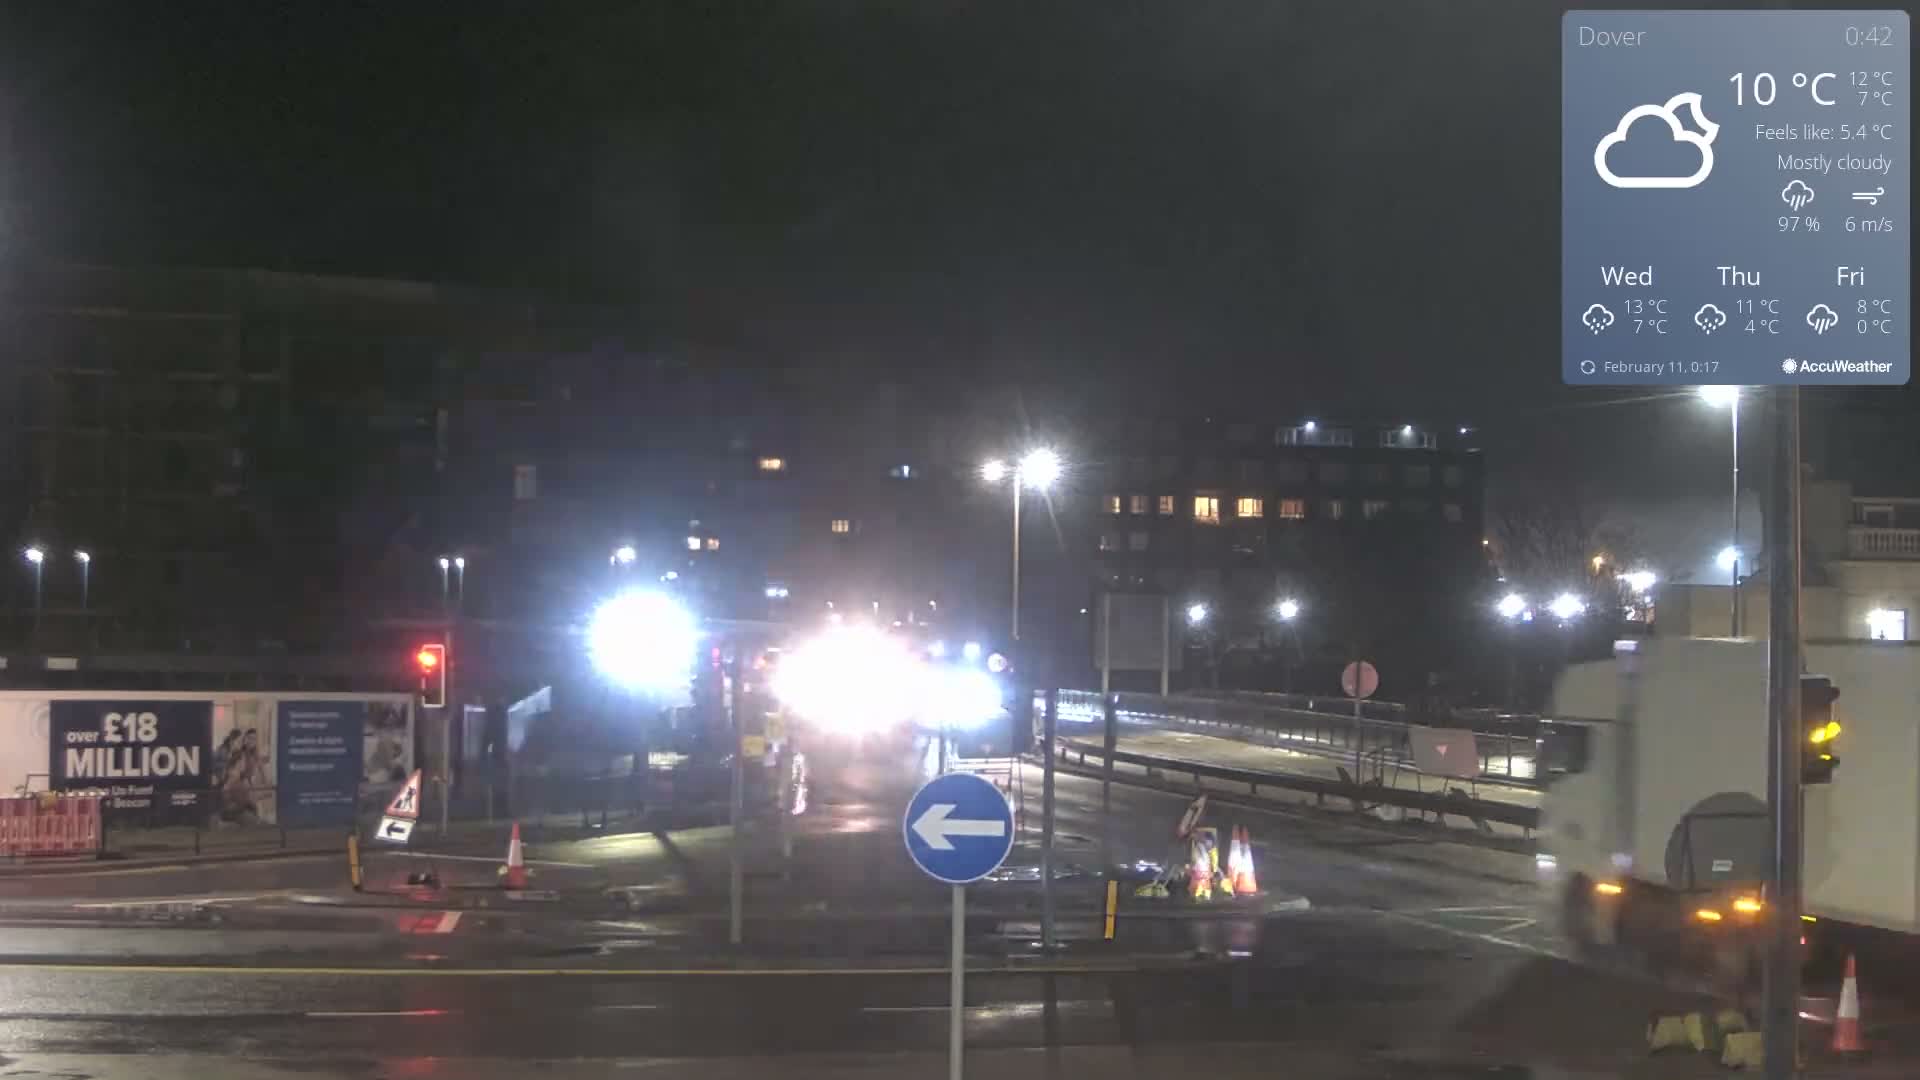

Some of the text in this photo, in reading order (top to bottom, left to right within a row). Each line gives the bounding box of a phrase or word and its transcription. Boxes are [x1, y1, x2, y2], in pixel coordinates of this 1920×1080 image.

[66, 712, 158, 743] over £18
[65, 746, 200, 778] MILLION
